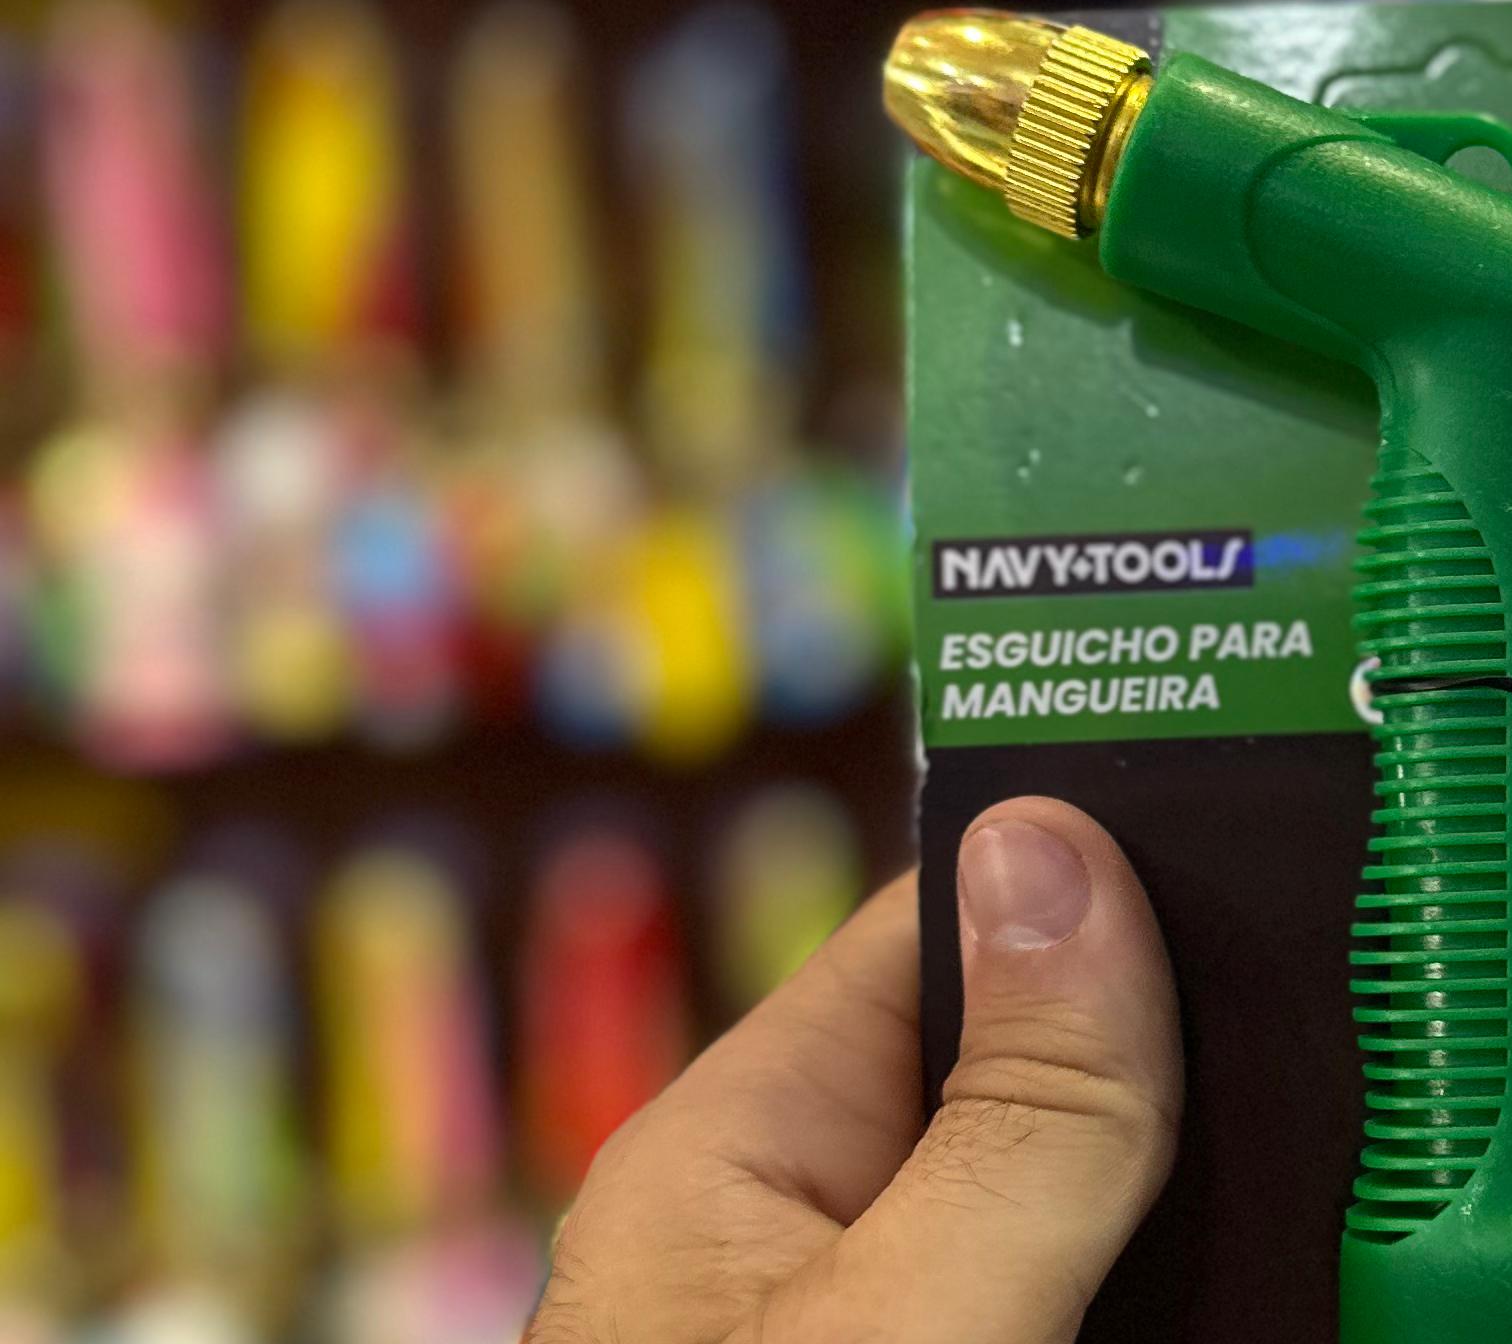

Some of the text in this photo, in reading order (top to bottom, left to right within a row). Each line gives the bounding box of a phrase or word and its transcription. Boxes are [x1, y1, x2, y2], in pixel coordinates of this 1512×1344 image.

[939, 620, 1314, 671] ESGUICHO PARA
[941, 673, 1221, 720] MANGUEIRA
